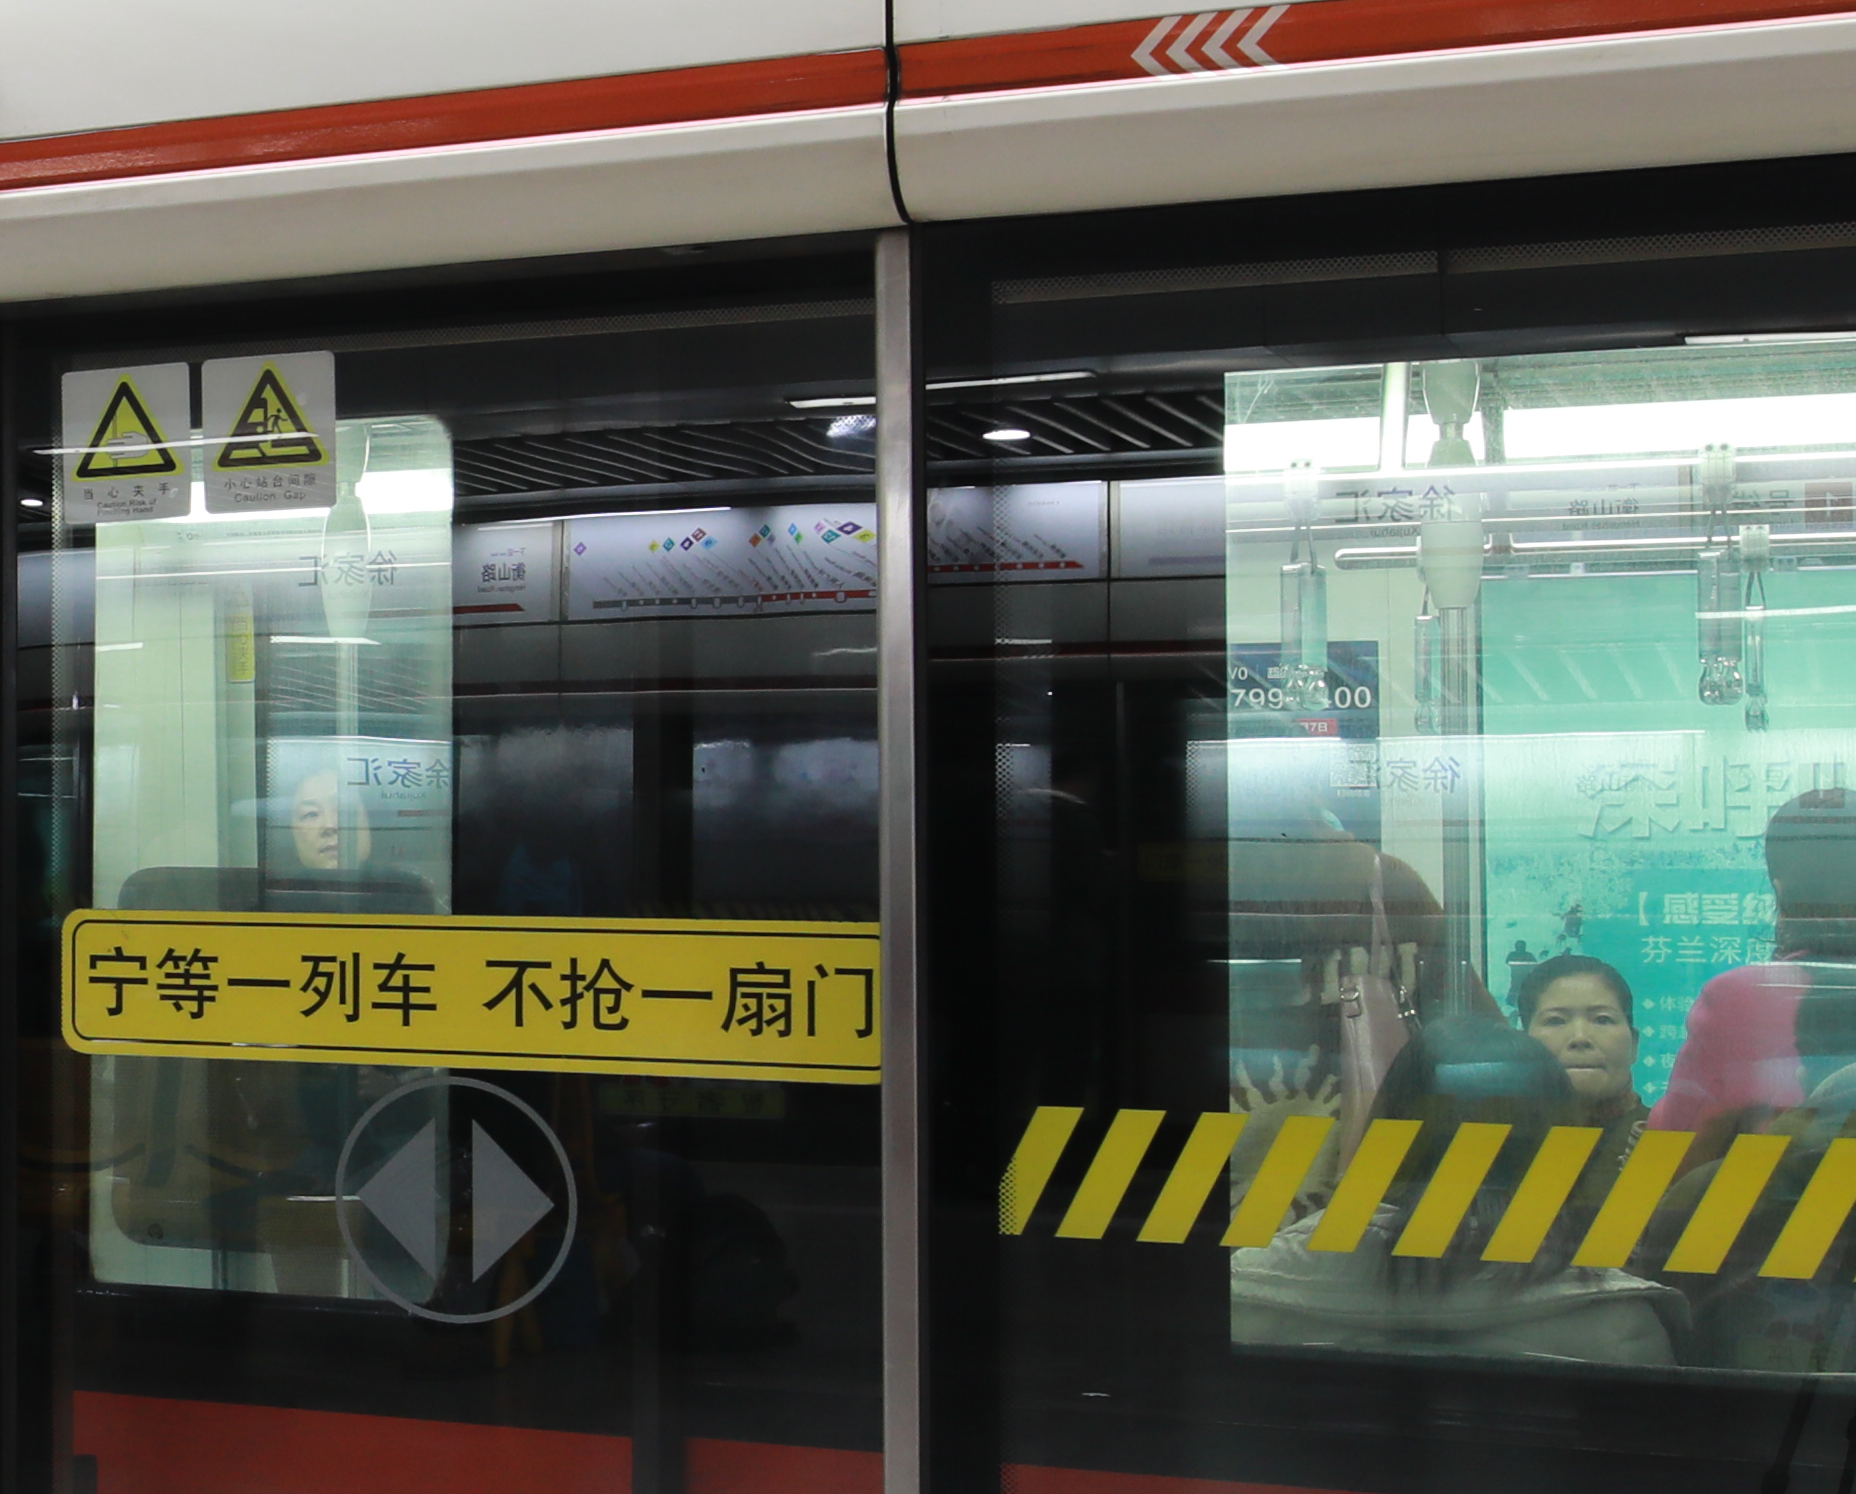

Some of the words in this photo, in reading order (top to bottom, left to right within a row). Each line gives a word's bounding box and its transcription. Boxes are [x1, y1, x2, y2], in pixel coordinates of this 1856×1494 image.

[83, 482, 171, 500] 当心夹手
[88, 946, 439, 1029] 宁等一列车
[483, 955, 876, 1040] 不抢一扇门
